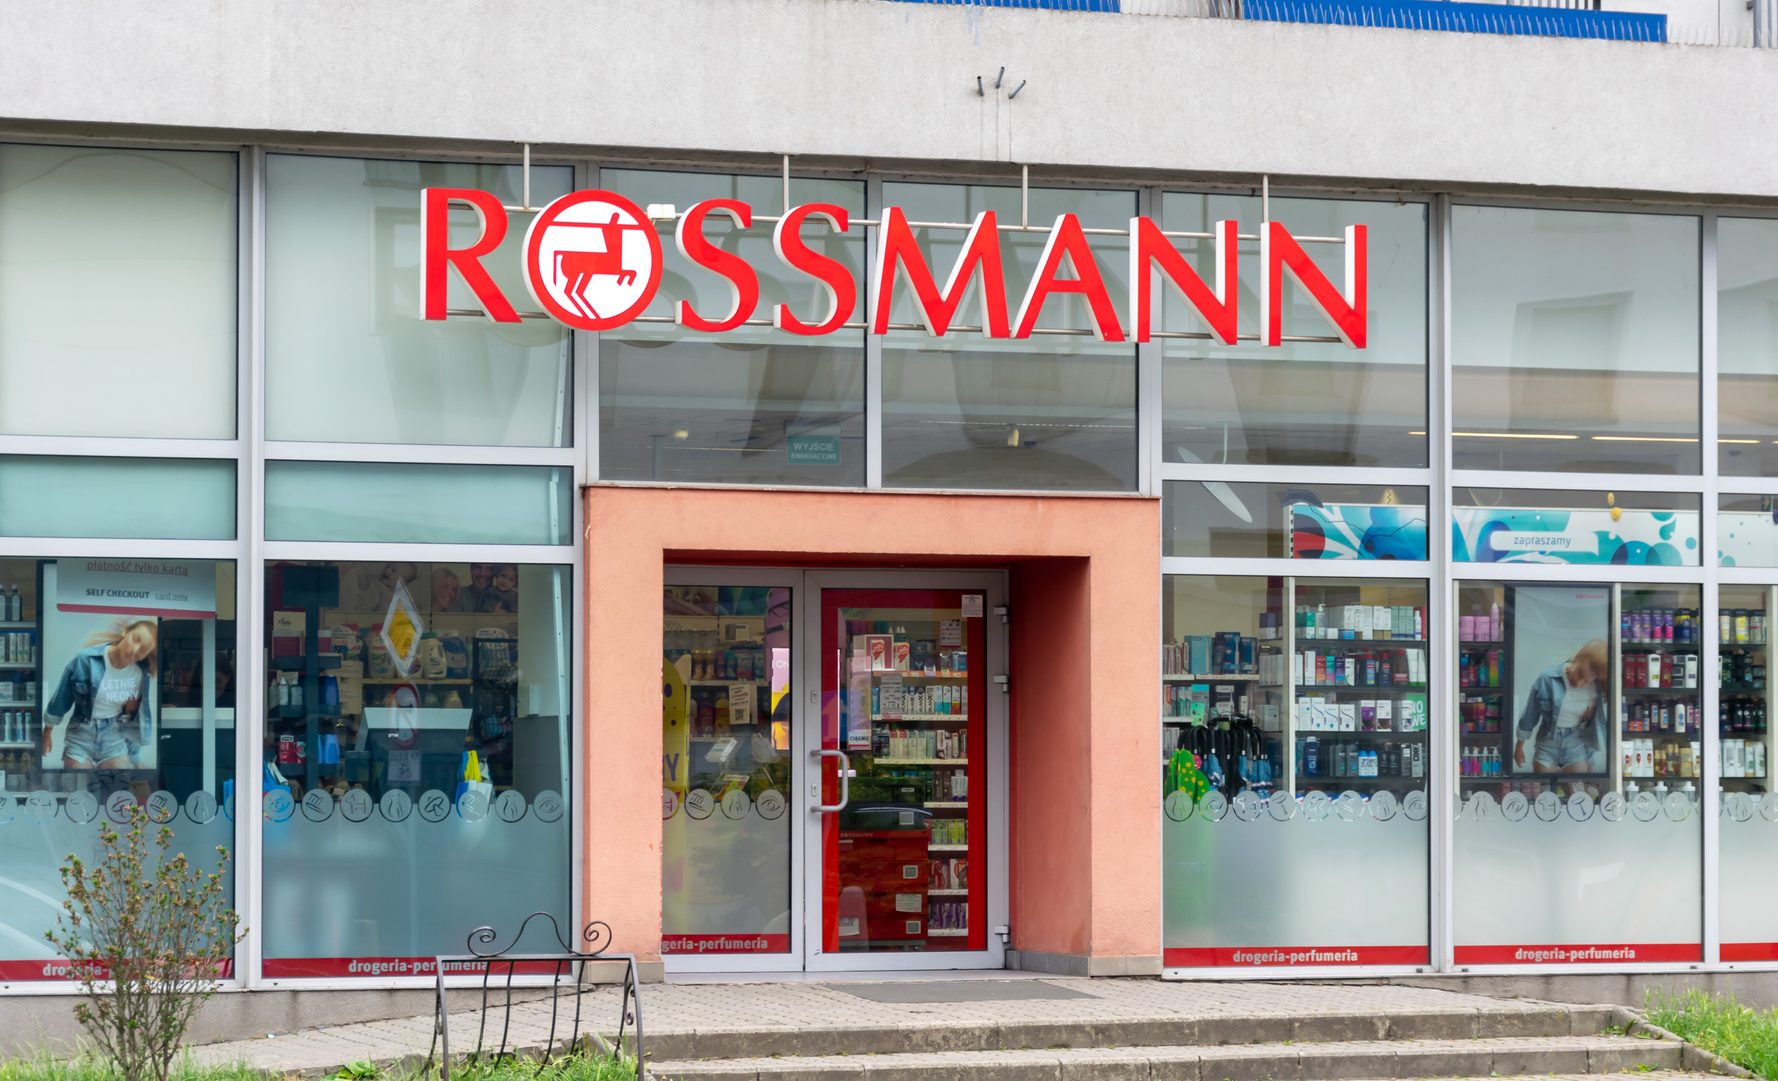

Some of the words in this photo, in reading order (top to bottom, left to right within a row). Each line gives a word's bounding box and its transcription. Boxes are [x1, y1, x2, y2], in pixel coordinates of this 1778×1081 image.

[419, 187, 1369, 349] ROSSMANN
[1513, 536, 1571, 548] zapraszamy
[134, 562, 160, 574] tylko
[86, 588, 105, 597] SELF
[106, 589, 150, 599] CHECKOUT
[662, 936, 768, 953] geria-perfumeria
[1233, 948, 1359, 965] drogeria-perfumeria
[1514, 946, 1636, 963] drogeria-perfumeria
